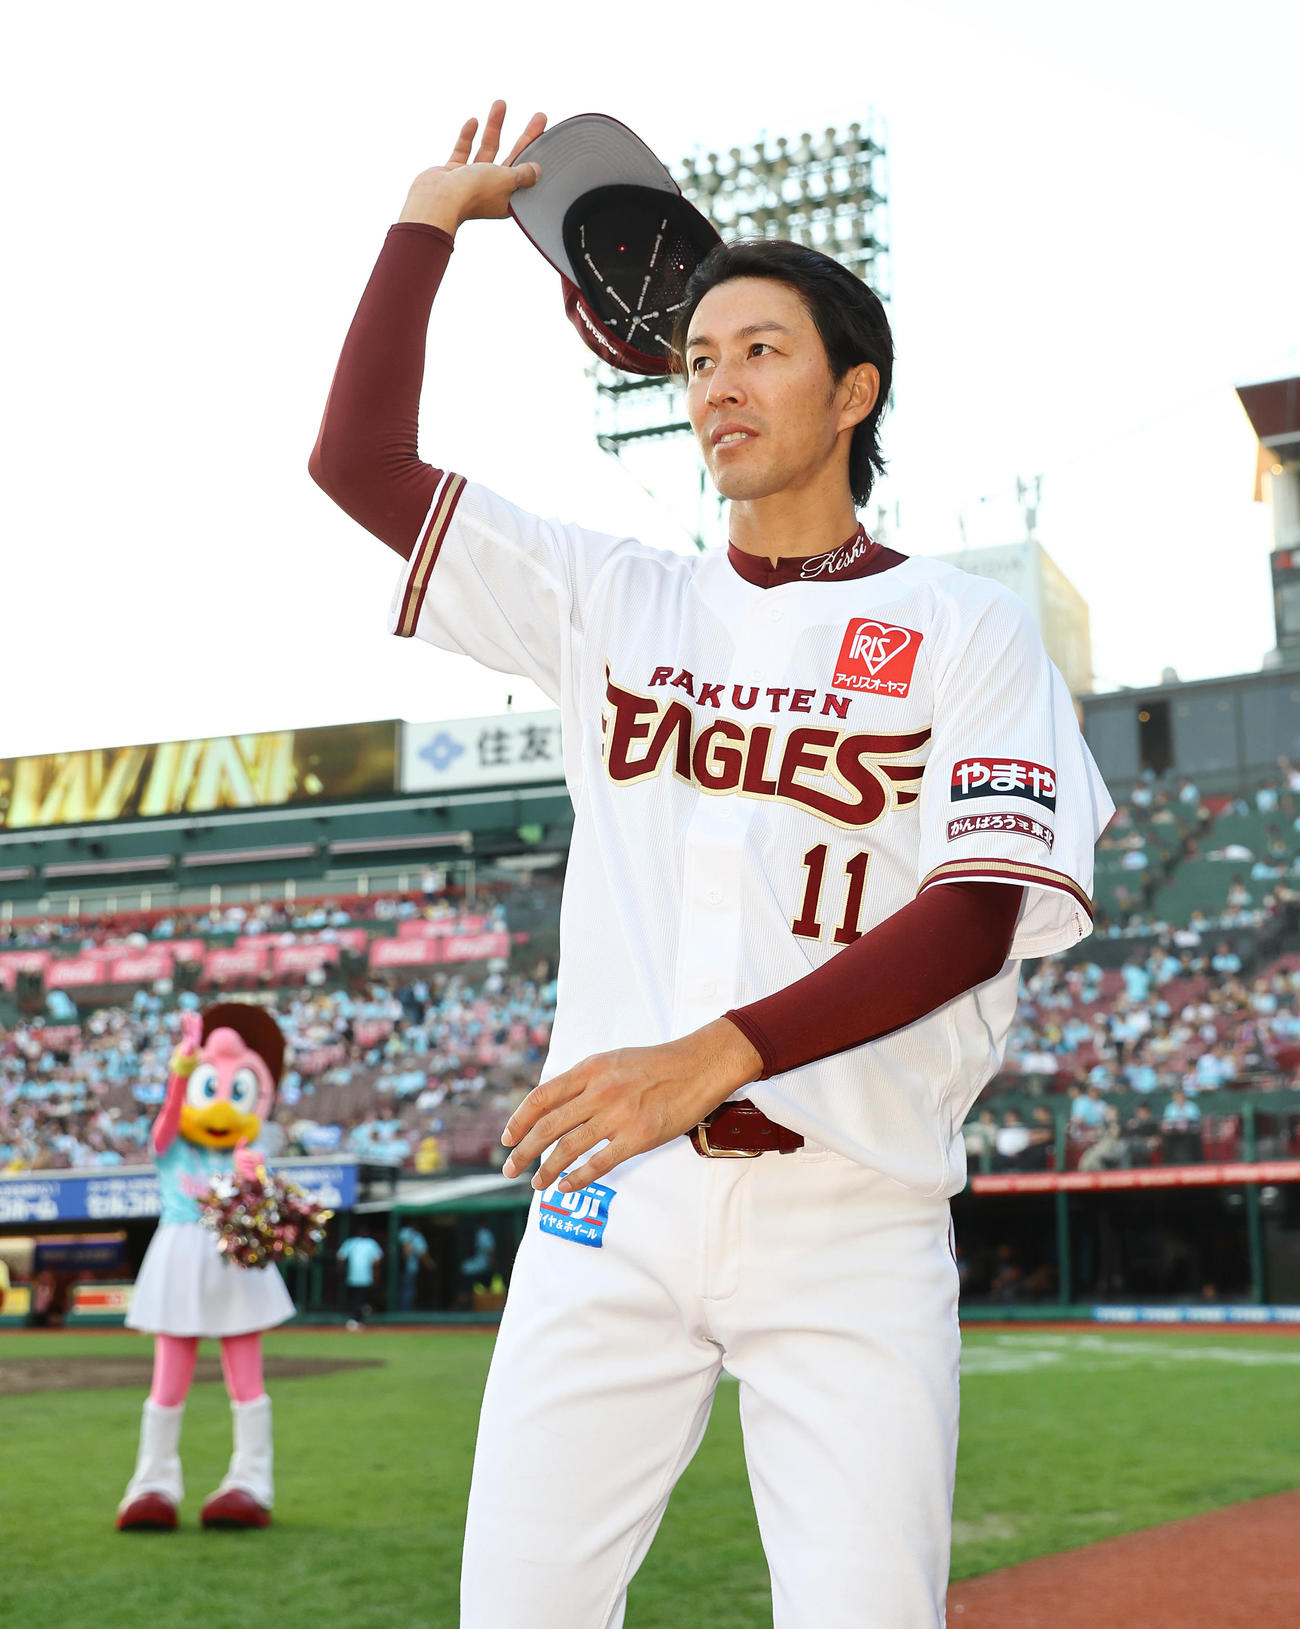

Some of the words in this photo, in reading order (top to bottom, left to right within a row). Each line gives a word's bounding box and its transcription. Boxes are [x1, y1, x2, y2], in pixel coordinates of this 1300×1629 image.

[800, 535, 867, 579] Kishi
[848, 633, 891, 662] IRIS
[648, 666, 852, 719] RAKUTEN
[834, 673, 908, 695] アイリスオーヤマ
[601, 658, 932, 831] EAGLES
[6, 731, 296, 829] WIN
[956, 762, 1056, 798] やまや
[950, 815, 1016, 836] がんばろう
[791, 841, 873, 947] 11
